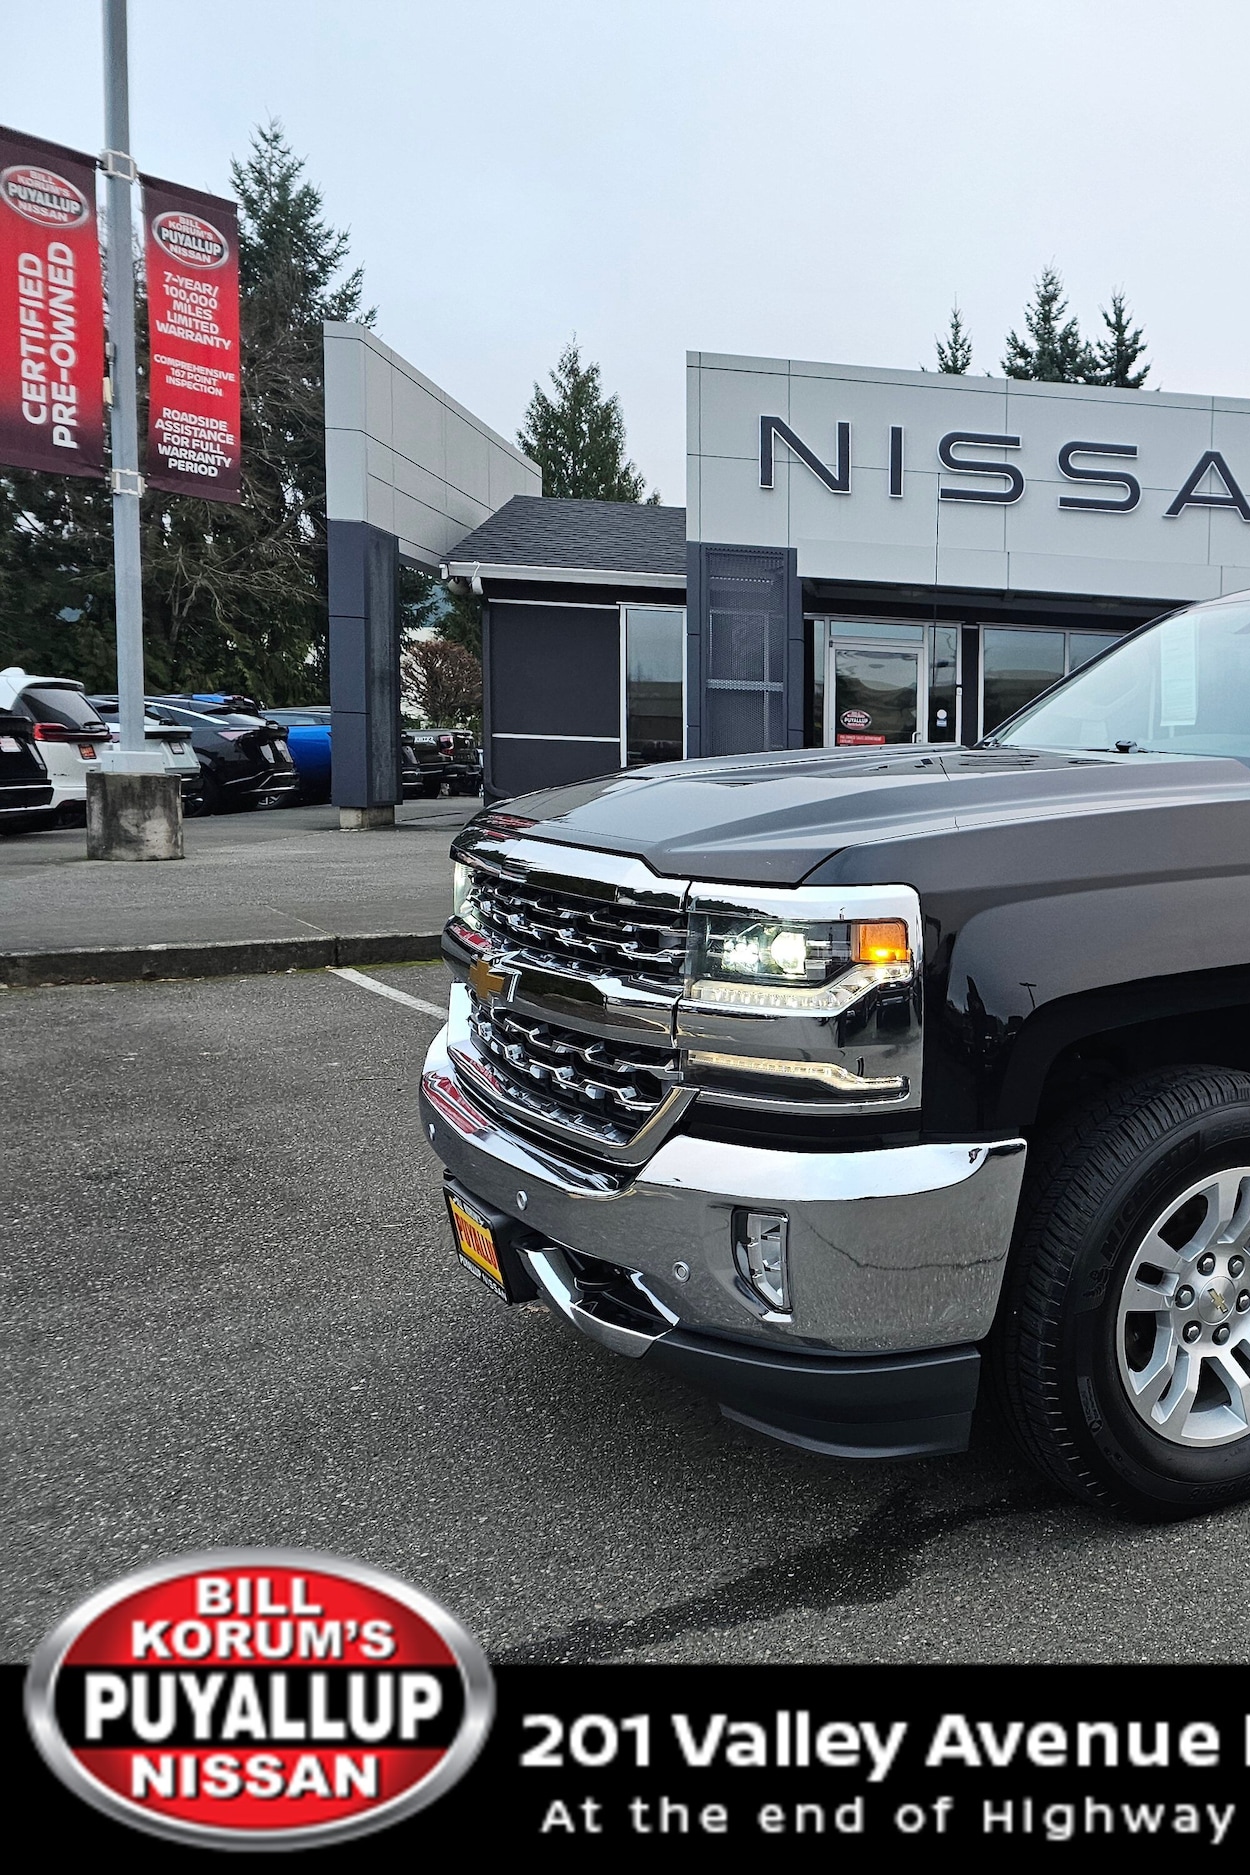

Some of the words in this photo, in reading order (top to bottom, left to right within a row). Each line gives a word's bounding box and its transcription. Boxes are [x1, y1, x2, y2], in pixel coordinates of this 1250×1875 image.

[8, 181, 81, 214] PUYALLUP
[18, 200, 68, 222] NISSAN
[179, 216, 202, 229] BILL
[161, 227, 222, 255] PUYALLUP
[168, 220, 213, 240] KORUM'S
[169, 243, 211, 263] NISSAN
[163, 271, 219, 297] 7-YEAR/
[162, 284, 218, 310] 100,000
[172, 299, 213, 320] MILES
[166, 310, 219, 334] LIMITED
[18, 252, 47, 425] CERTIFIED
[47, 241, 78, 449] PRE-OWNED
[155, 320, 231, 350] WARRANTY
[153, 354, 236, 382] COMPREHENSIVE
[171, 367, 186, 378] 167
[187, 373, 218, 386] POINT
[165, 375, 223, 397] INSPECTION
[155, 418, 235, 446] ASSISTANCE
[162, 407, 228, 432] ROADSIDE
[157, 443, 232, 468] WARRANTY
[163, 432, 190, 448] FOR
[192, 439, 224, 455] FULL
[168, 458, 218, 477] PERIOD
